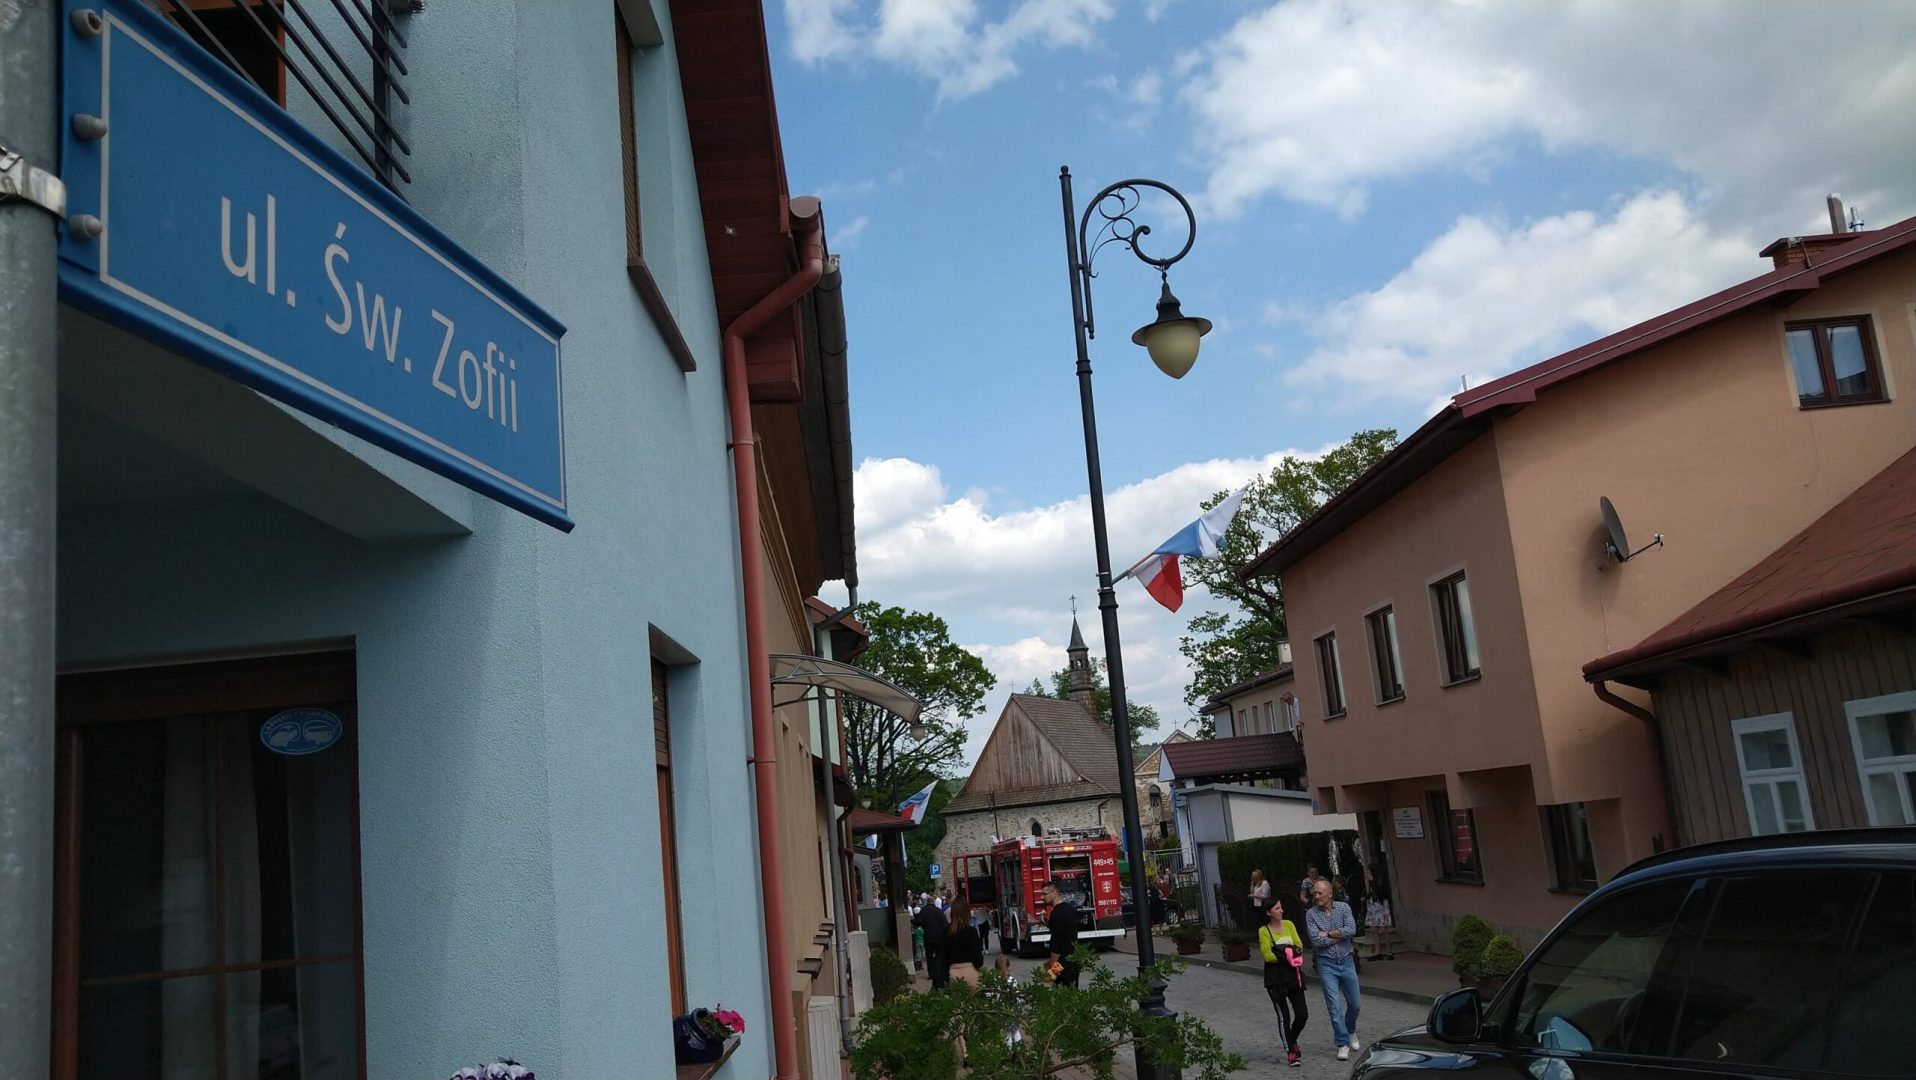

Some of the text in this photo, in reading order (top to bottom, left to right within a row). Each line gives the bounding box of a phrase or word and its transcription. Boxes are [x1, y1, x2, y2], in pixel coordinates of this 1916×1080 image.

[220, 193, 518, 433] ul. Św. Zofii
[932, 865, 939, 874] P
